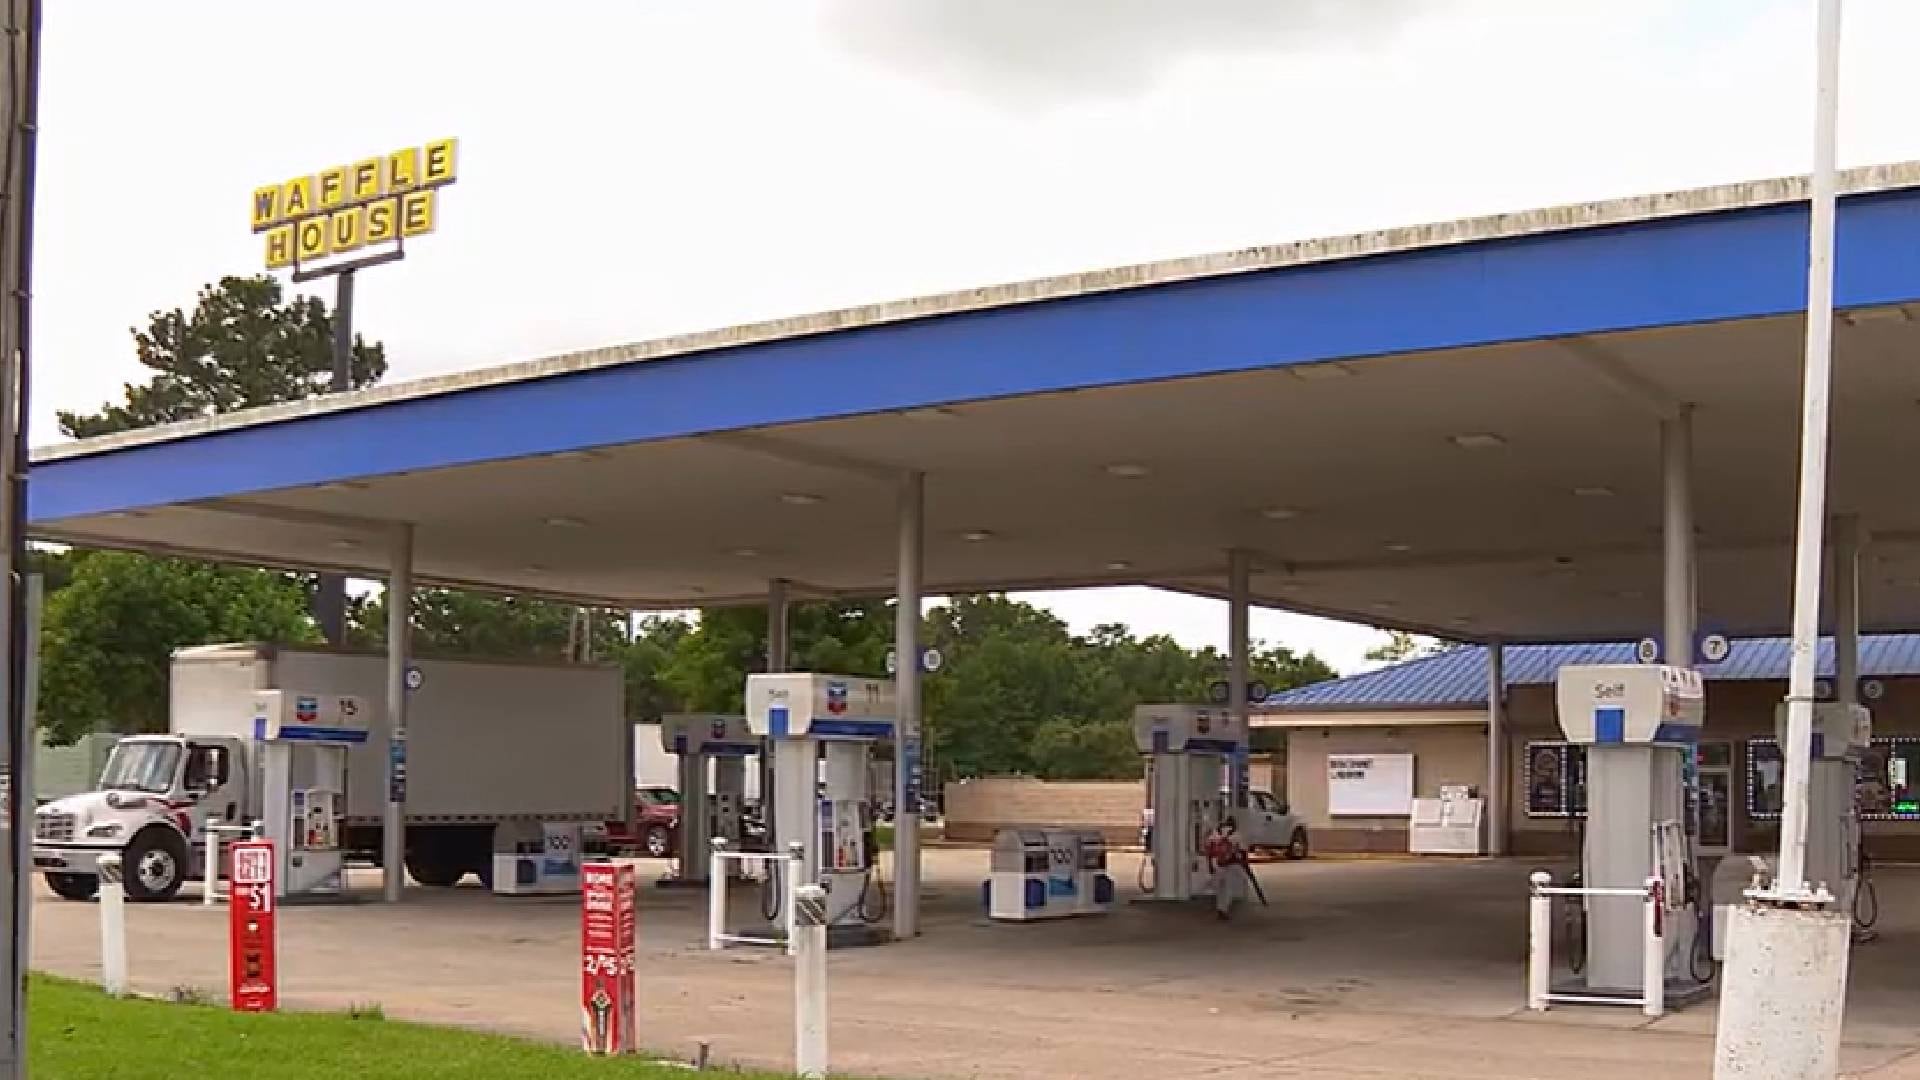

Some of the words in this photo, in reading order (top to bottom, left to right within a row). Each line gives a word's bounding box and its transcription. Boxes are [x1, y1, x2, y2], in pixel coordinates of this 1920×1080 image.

[254, 142, 448, 222] WAFFLE
[267, 196, 428, 263] HOUSE
[1709, 640, 1721, 655] 7
[1593, 682, 1626, 699] Self
